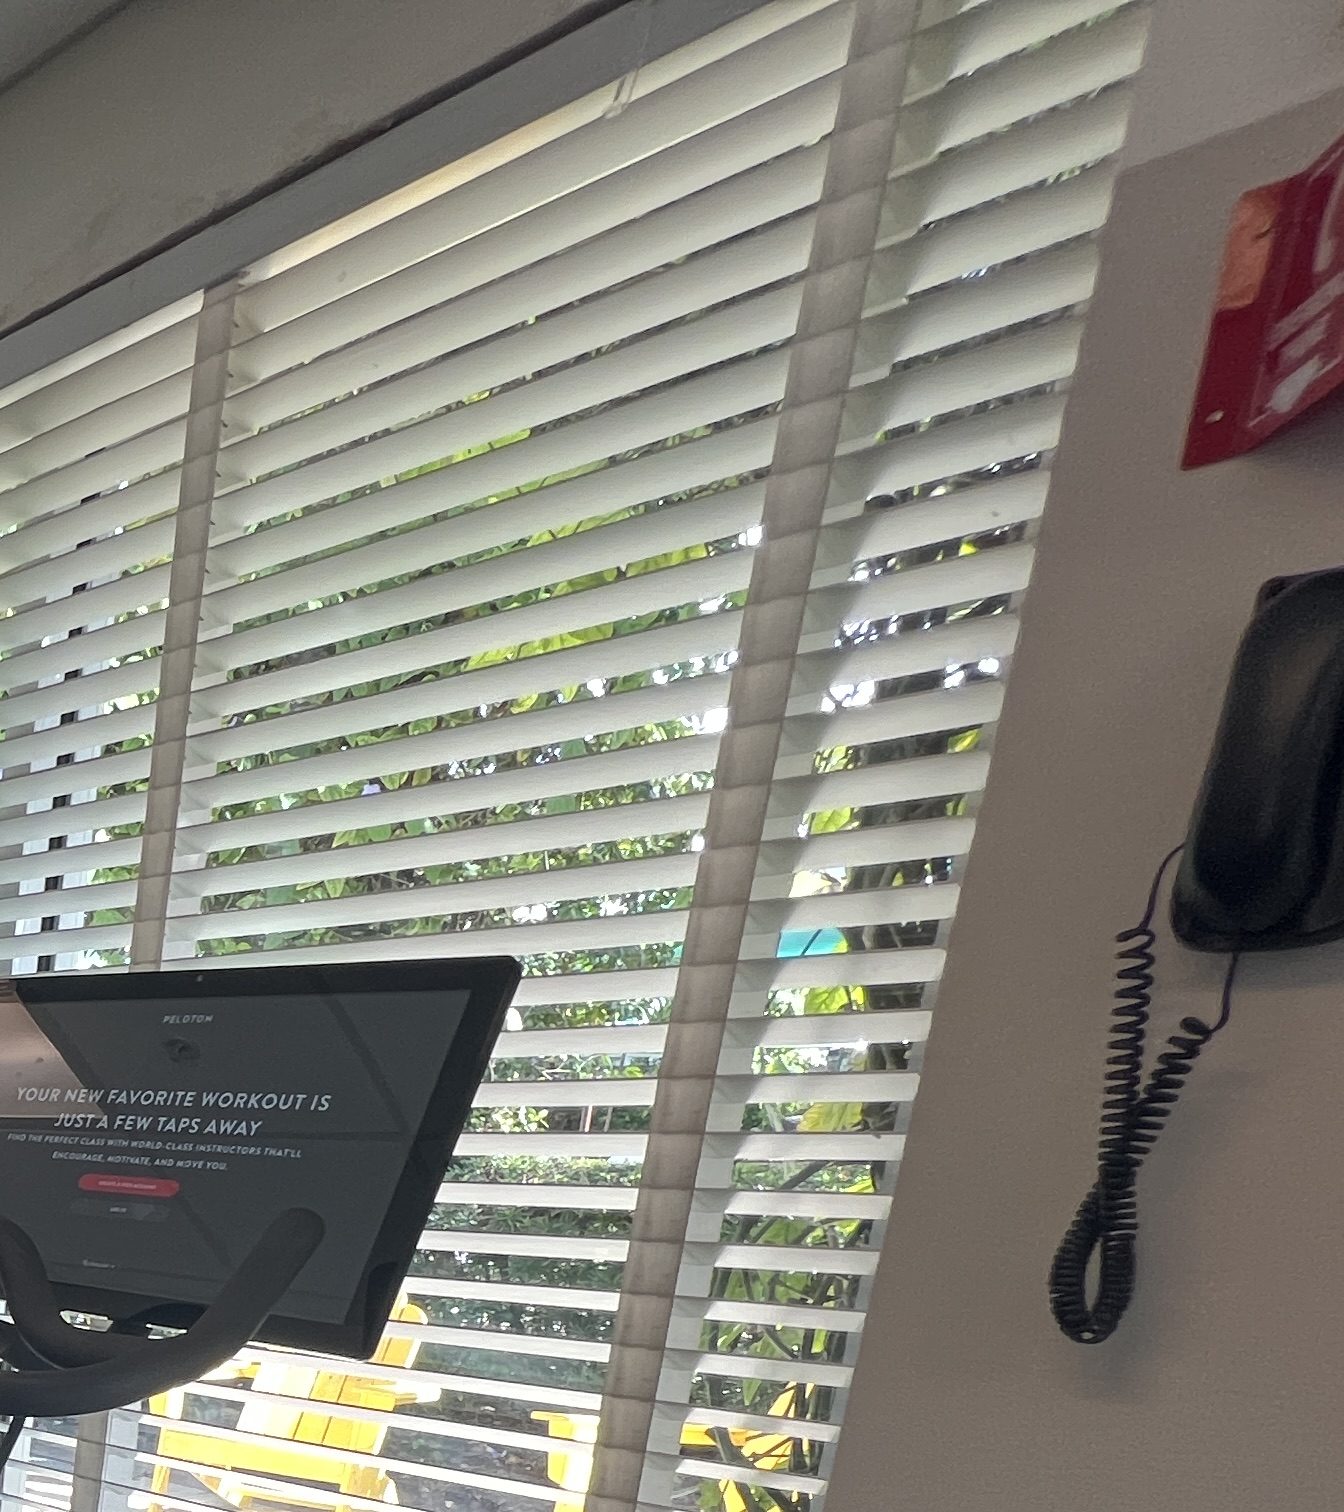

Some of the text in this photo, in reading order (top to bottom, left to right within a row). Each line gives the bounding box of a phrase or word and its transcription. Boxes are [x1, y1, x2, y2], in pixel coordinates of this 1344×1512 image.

[162, 1014, 214, 1024] PELOTON
[17, 1087, 332, 1111] YOUR NEW FAVORITE WORKOUT IS
[53, 1113, 263, 1136] JUST A FEW TAPS AWAY
[7, 1133, 26, 1142] FIND
[28, 1134, 43, 1143] THE
[44, 1135, 79, 1145] PERFECT
[79, 1137, 106, 1146] CLASS
[106, 1138, 128, 1147] WITH
[195, 1143, 261, 1155] INSTRUCTORS
[263, 1147, 303, 1159] THAT'LL
[52, 1151, 105, 1163] ENCOURAGE,
[106, 1154, 152, 1166] MOTIVATE,
[153, 1157, 174, 1167] AND
[176, 1159, 204, 1169] MOVE
